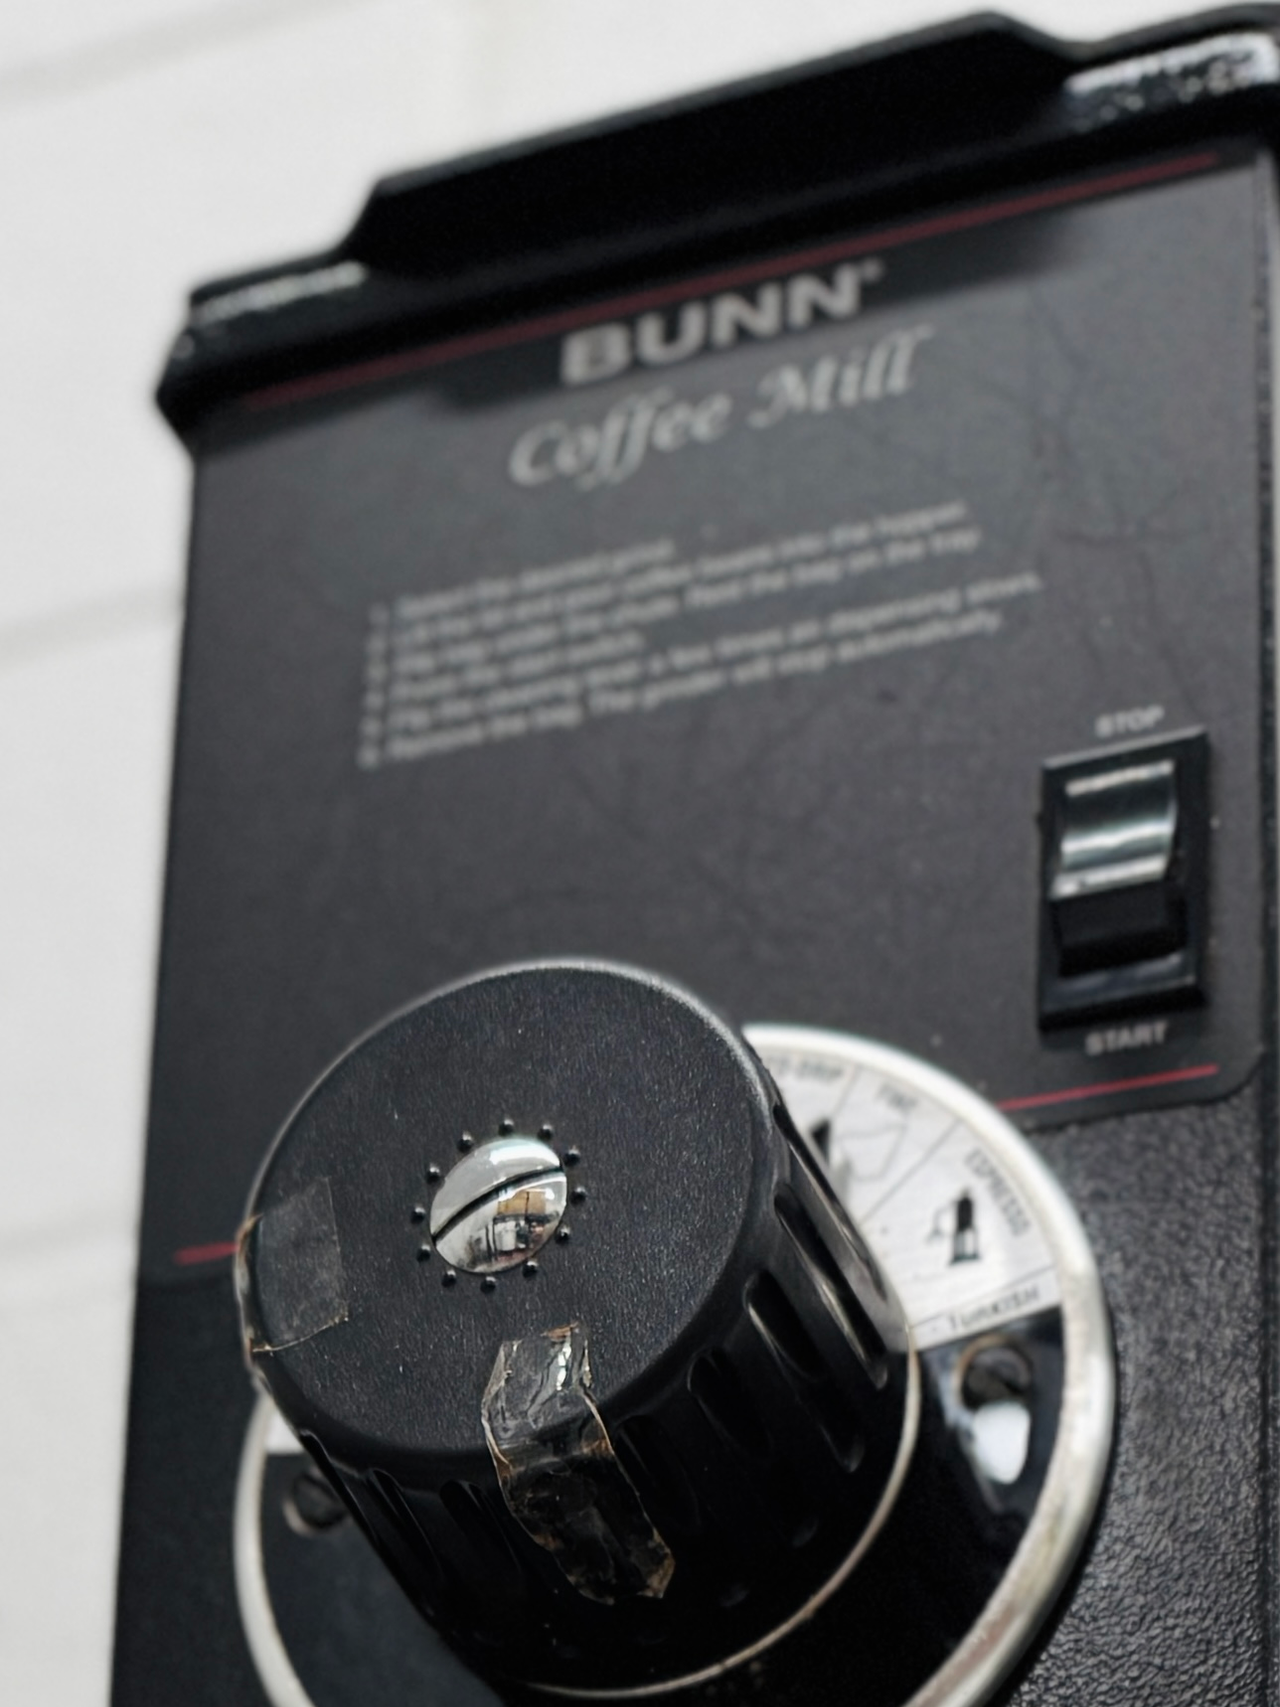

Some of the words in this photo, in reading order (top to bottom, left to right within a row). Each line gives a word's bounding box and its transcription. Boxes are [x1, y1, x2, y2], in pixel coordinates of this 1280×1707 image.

[509, 386, 732, 491] Coffee
[747, 324, 934, 430] Mill
[1094, 705, 1165, 738] STOP
[1086, 1020, 1168, 1056] START
